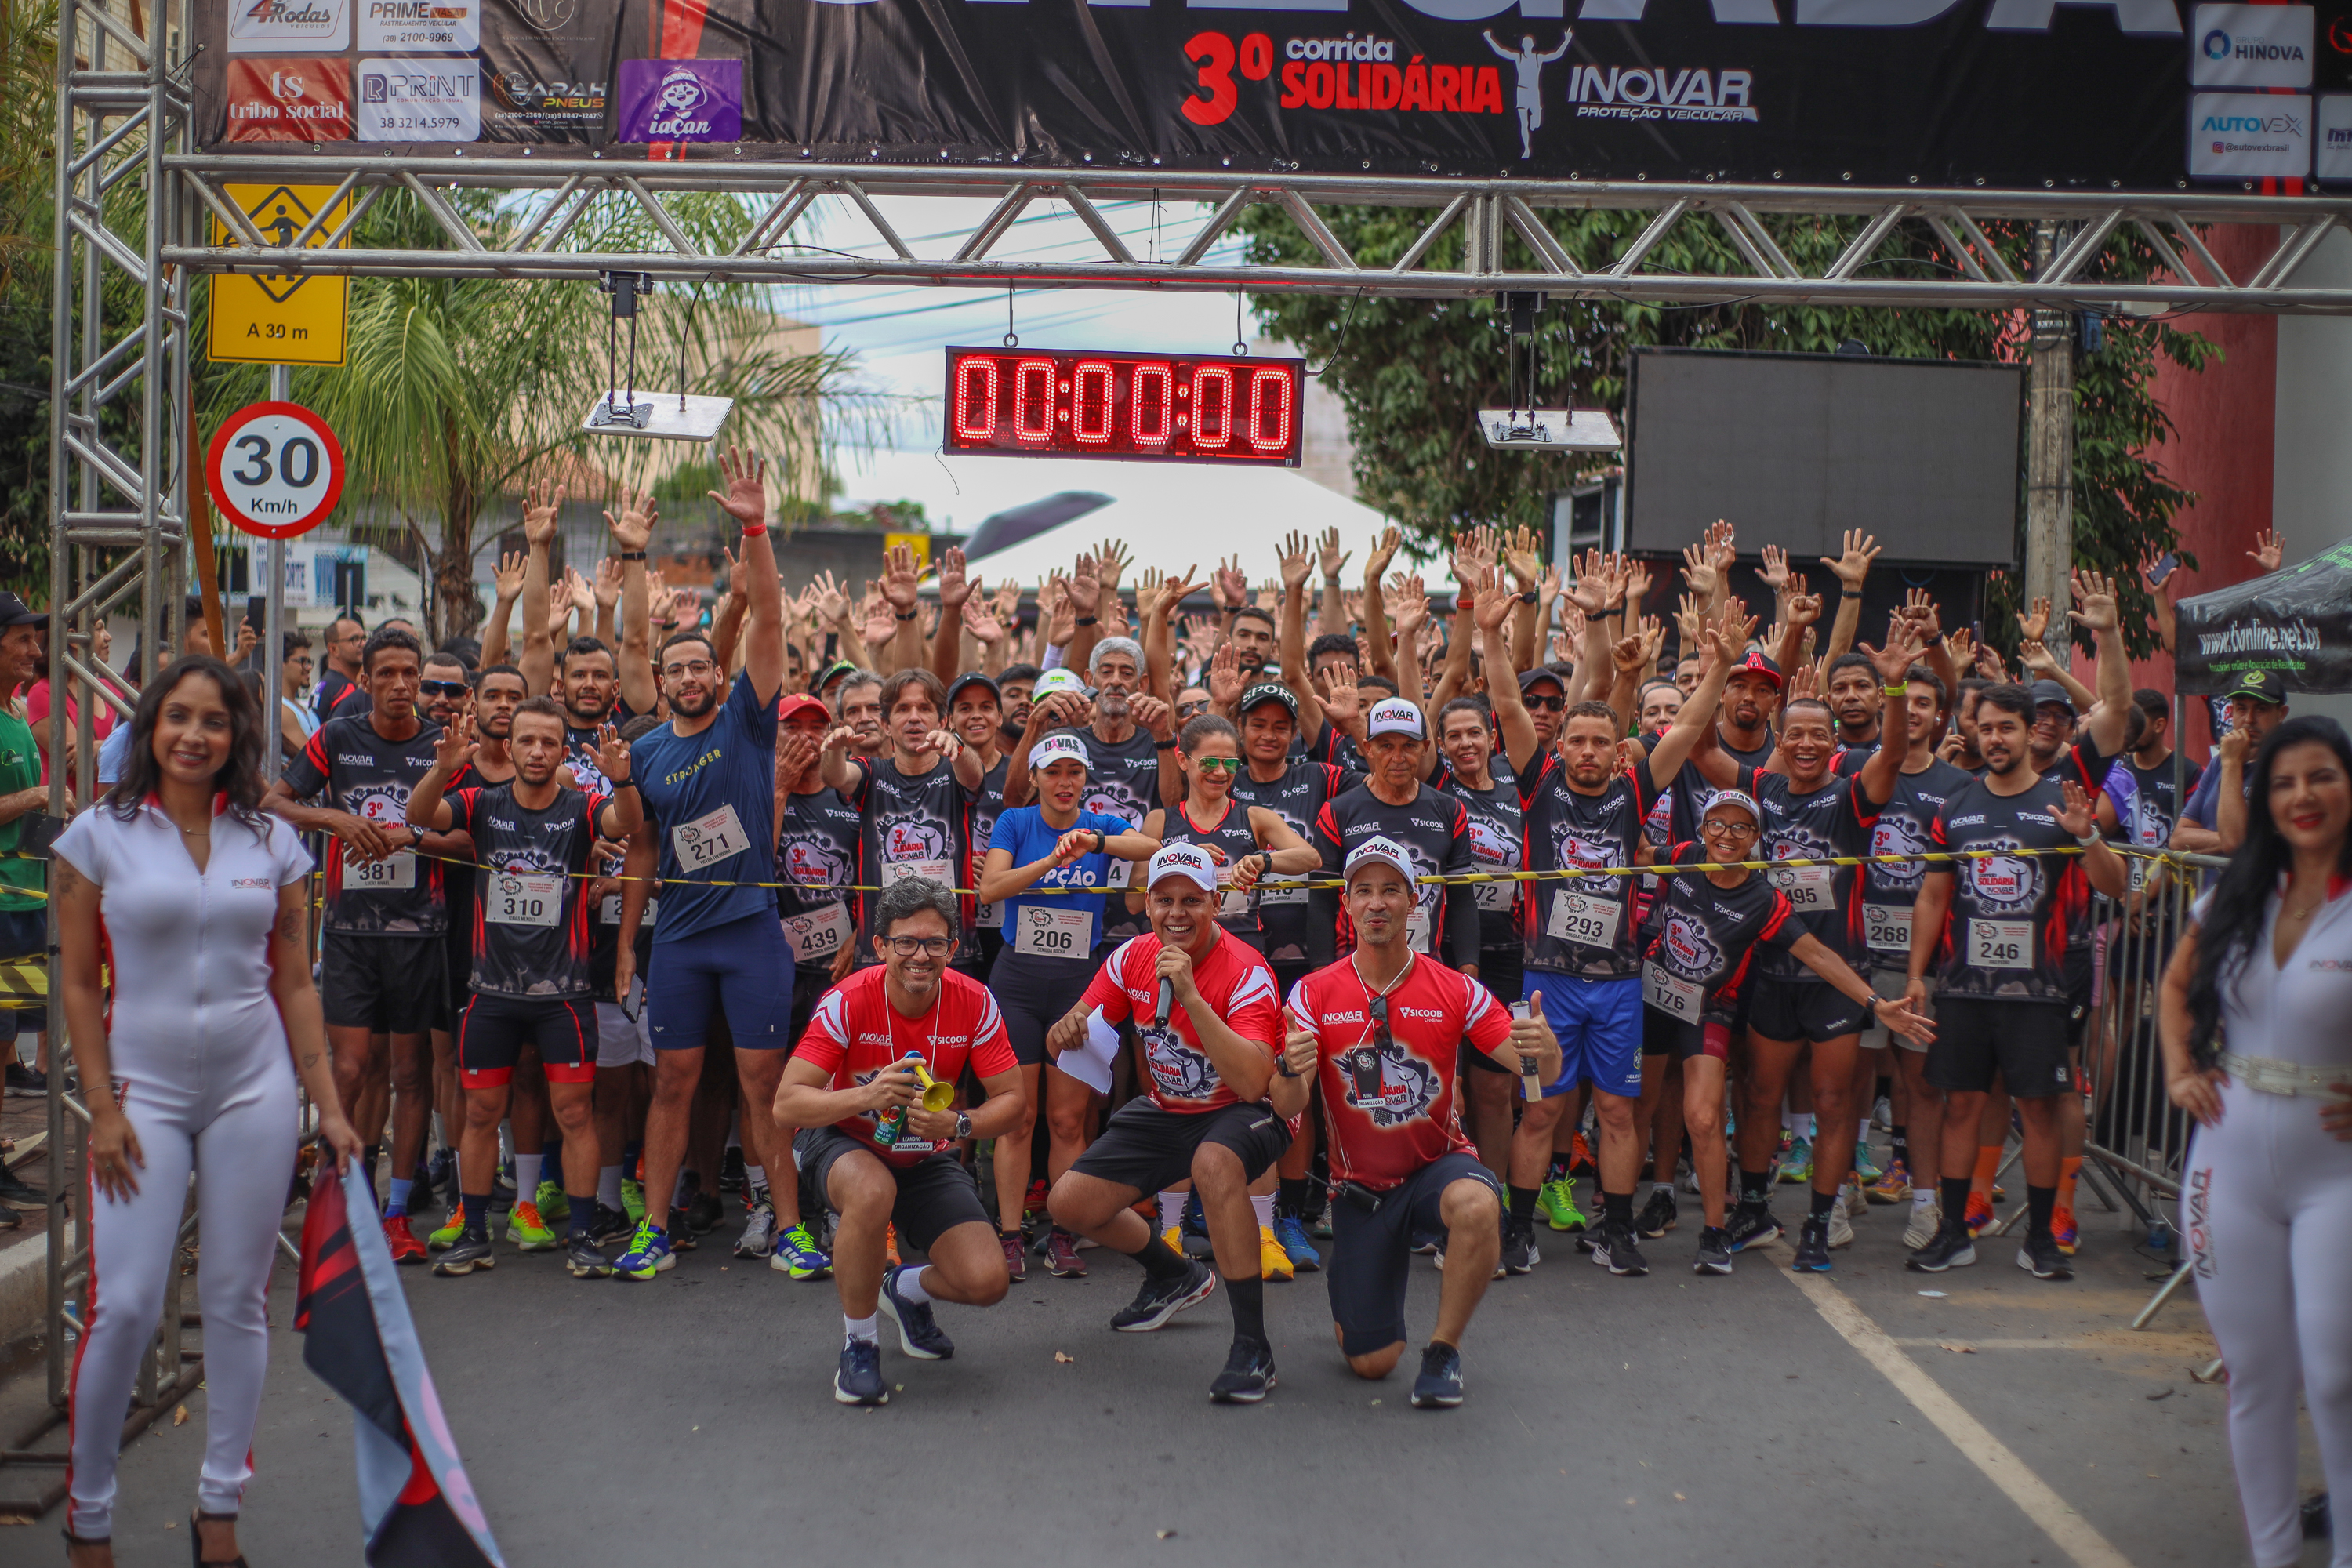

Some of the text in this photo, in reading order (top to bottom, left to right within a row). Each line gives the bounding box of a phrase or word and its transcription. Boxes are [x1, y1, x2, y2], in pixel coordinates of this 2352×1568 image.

[369, 2, 466, 19] PRIME VIASAT
[383, 32, 454, 43] (38) 2100-9969
[1285, 32, 1393, 61] corrida
[2235, 45, 2305, 60] HINOVA
[510, 82, 608, 96] SARAH
[1279, 55, 1504, 114] SOLIDÁRIA
[1568, 66, 1752, 107] INOVAR
[229, 100, 344, 119] tribo social
[543, 97, 604, 108] PNEUS
[1577, 107, 1744, 122] PROTEÇÃO VEICULAR
[380, 118, 459, 129] 38 3214.5979
[2225, 143, 2290, 153] @autovexbrasil
[246, 322, 308, 339] A 30 m
[231, 434, 319, 488] 30
[251, 497, 298, 514] Km/h
[1243, 684, 1298, 707] SPORT
[1374, 709, 1414, 721] INOVAR
[666, 749, 722, 786] STRONGER
[833, 810, 859, 819] SICOOB
[2026, 813, 2055, 822] SICOOB
[690, 833, 730, 861] 271
[1354, 844, 1399, 860] INOVAR
[896, 851, 924, 860] INOVAR
[1156, 852, 1202, 867] INOVAR
[358, 863, 396, 880] 381
[793, 866, 827, 877] SOLIDÁRIA
[1041, 865, 1097, 888] PÇÃO
[230, 877, 270, 887] INOVAR
[1977, 876, 2016, 886] SOLIDÁRIA
[1784, 887, 1817, 904] 495
[503, 898, 543, 916] 310
[1719, 906, 1744, 920] SICOOB
[1565, 915, 1604, 938] 293
[1871, 925, 1908, 942] 268
[800, 927, 838, 951] 439
[1033, 929, 1073, 949] 206
[1566, 931, 1582, 940] DOUGLAS
[804, 947, 823, 957] FRANCISCO
[1980, 942, 2020, 960] 246
[1654, 985, 1685, 1011] 176
[1321, 1011, 1363, 1022] INOVAR
[1410, 1009, 1443, 1018] SICOOB
[858, 1032, 892, 1042] INOVAR
[937, 1035, 967, 1044] SICOOB
[1157, 1073, 1181, 1085] INOVAR
[2190, 1170, 2212, 1280] INOVAR
